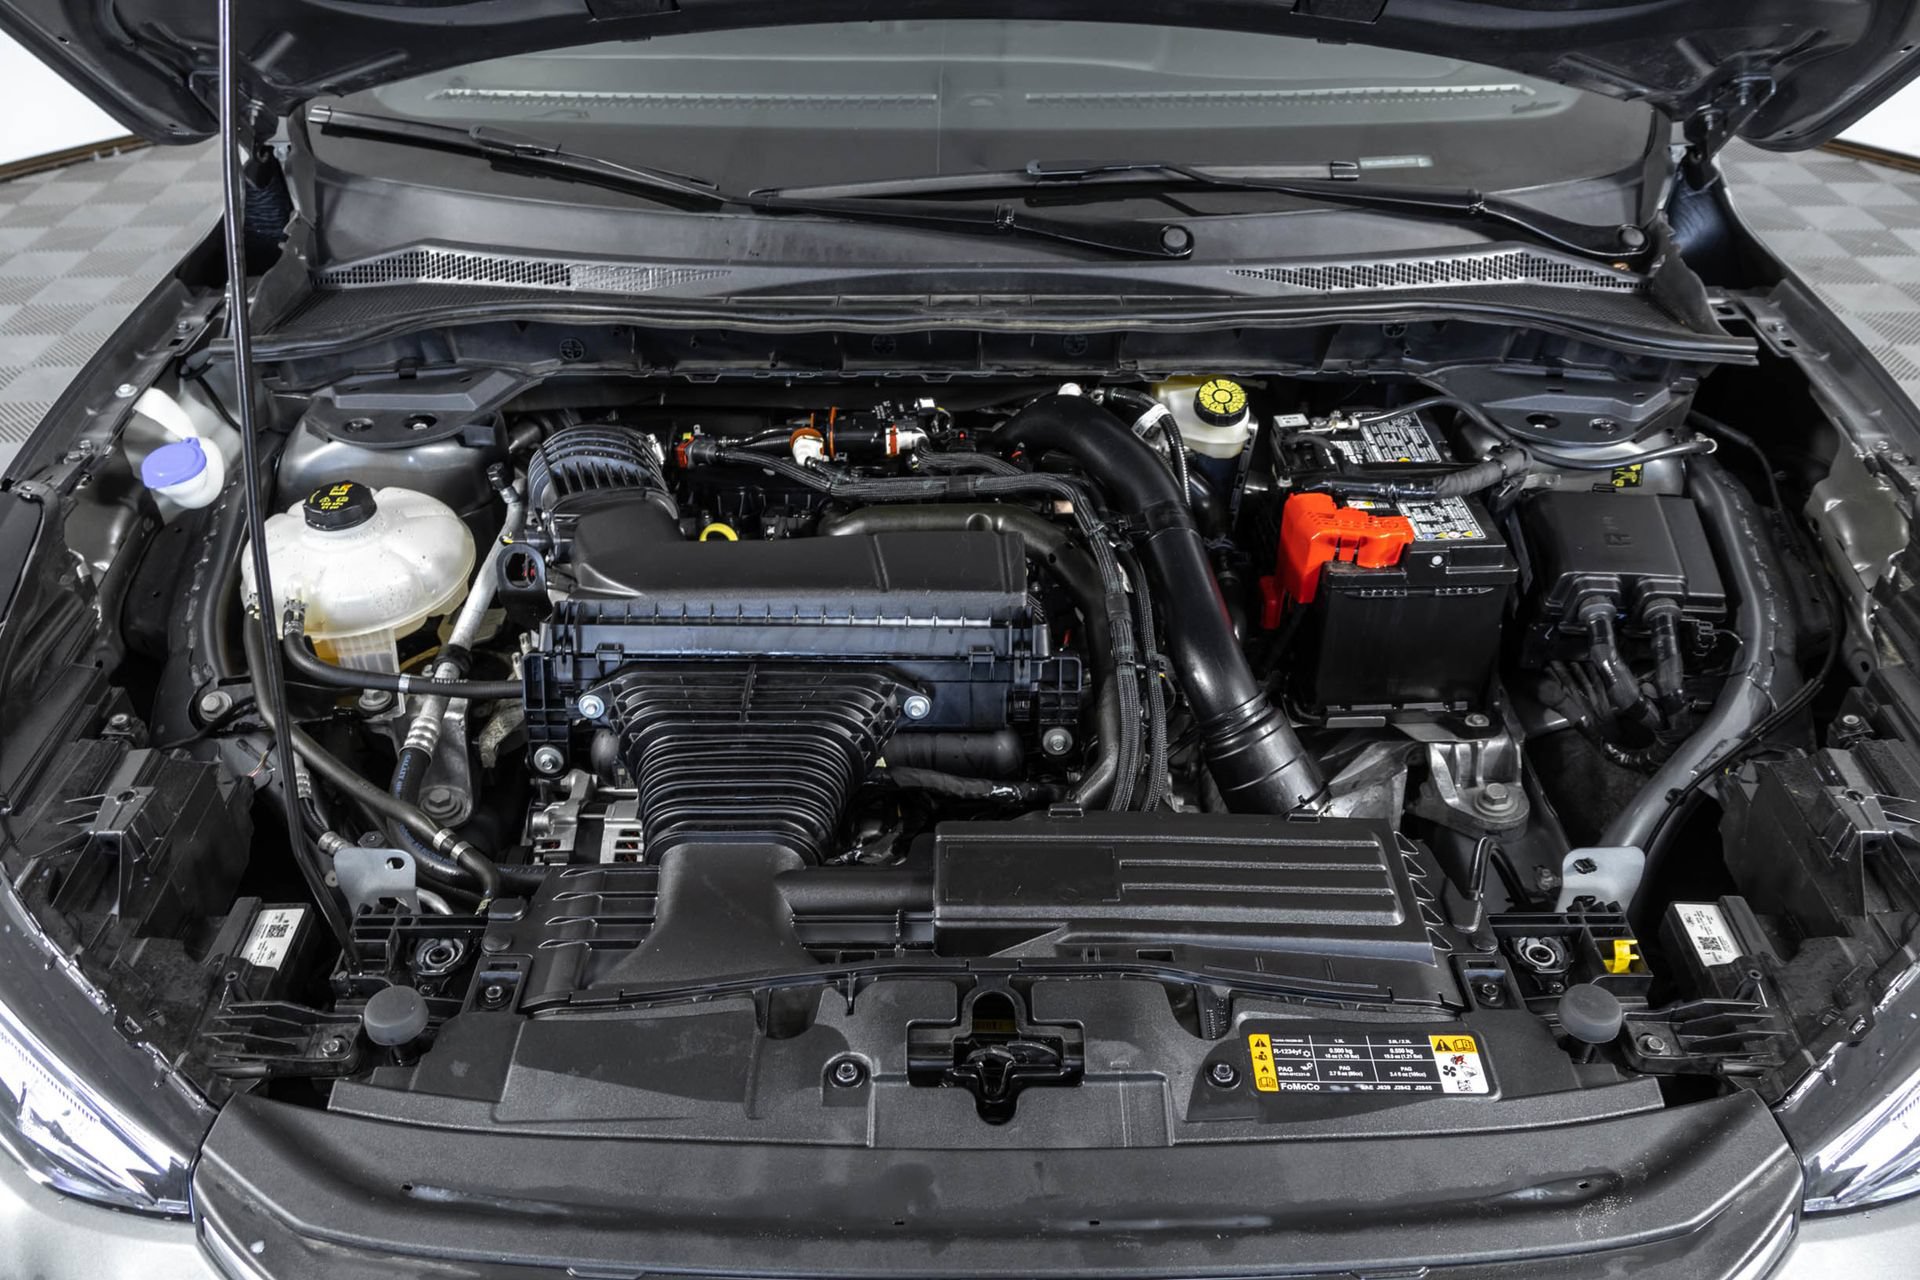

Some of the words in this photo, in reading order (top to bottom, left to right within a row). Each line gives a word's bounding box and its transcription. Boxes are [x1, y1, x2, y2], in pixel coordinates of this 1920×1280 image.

[1273, 1048, 1302, 1056] R-1234yf
[1345, 1047, 1353, 1055] kg
[1281, 1083, 1320, 1091] FoMoCo
